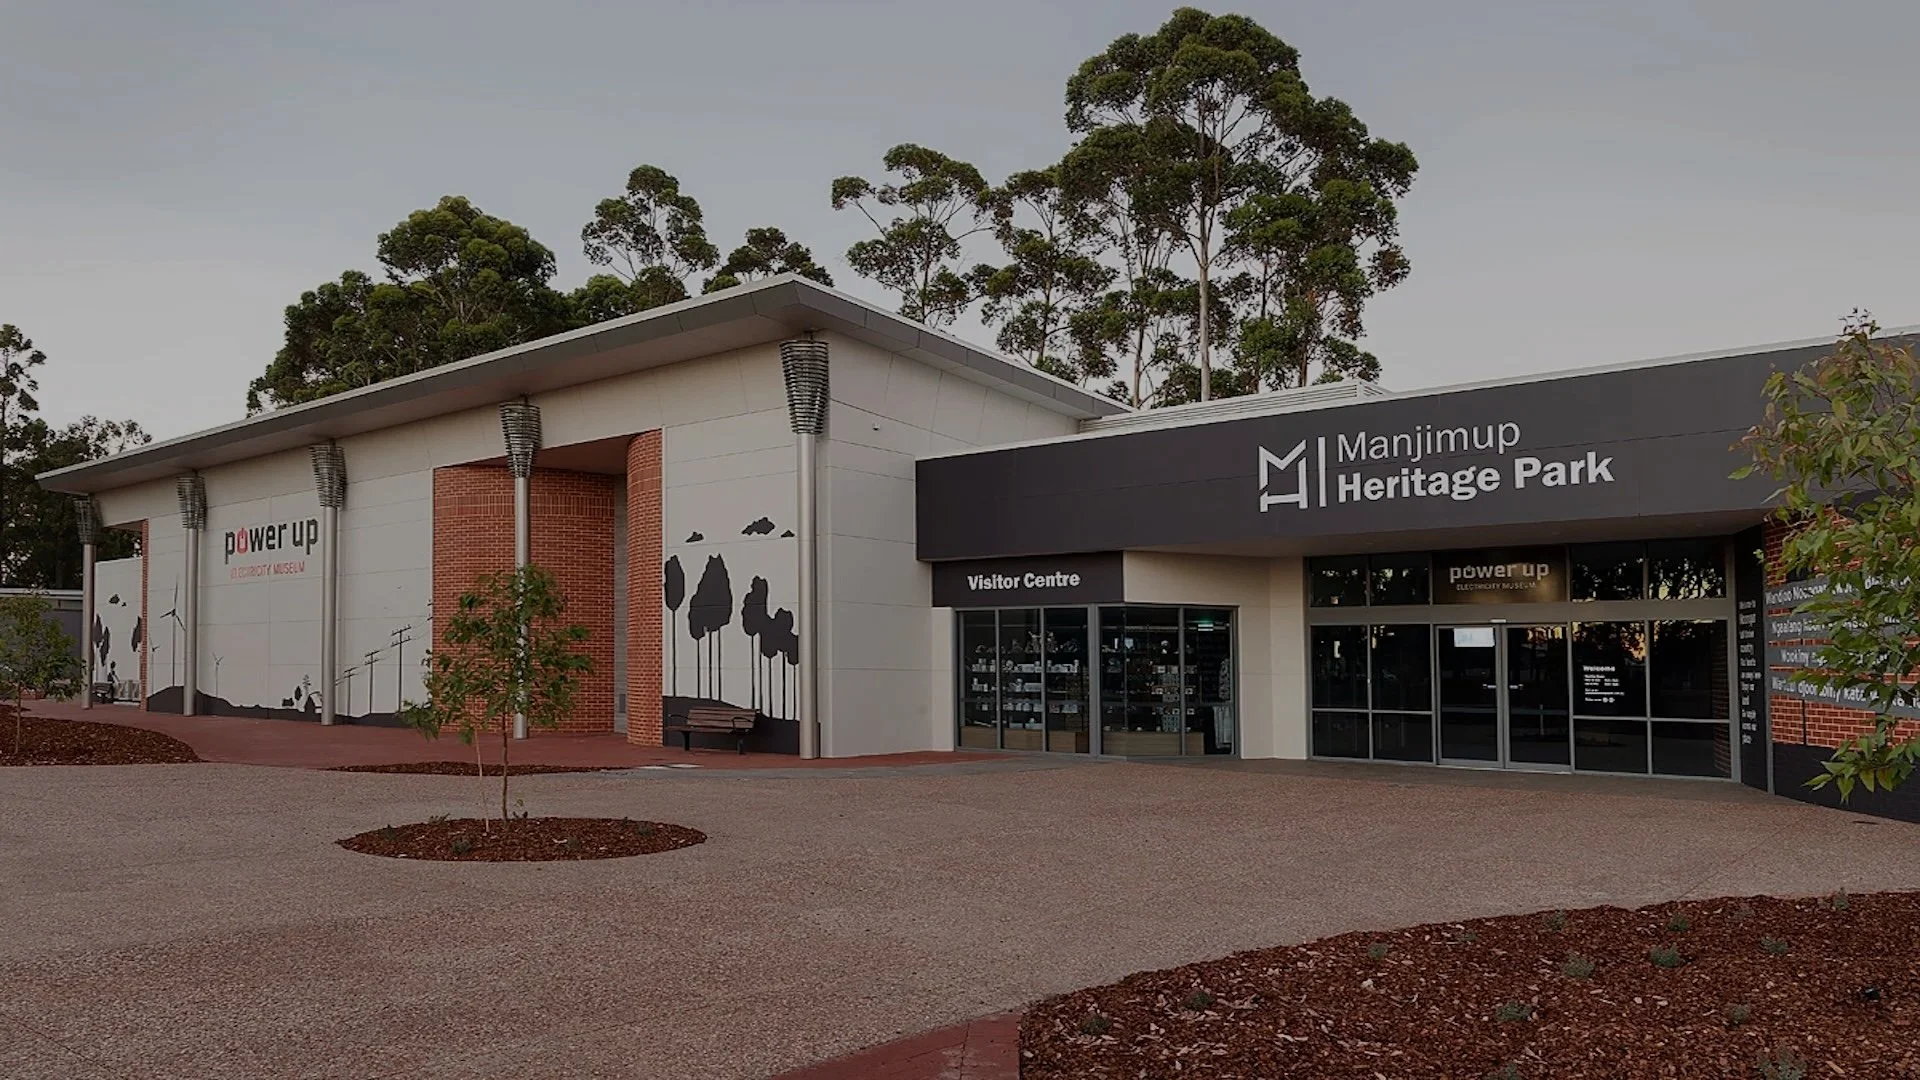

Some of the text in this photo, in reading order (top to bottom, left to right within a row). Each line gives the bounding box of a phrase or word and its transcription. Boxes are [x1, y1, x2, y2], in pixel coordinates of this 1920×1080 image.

[1337, 420, 1521, 463] Manjimup
[1338, 451, 1614, 502] Heritage Park
[225, 518, 318, 565] power up
[967, 571, 1081, 591] Visitor Centre
[1449, 563, 1550, 583] power up
[1456, 581, 1537, 591] ELECTRICITY MUSEUM
